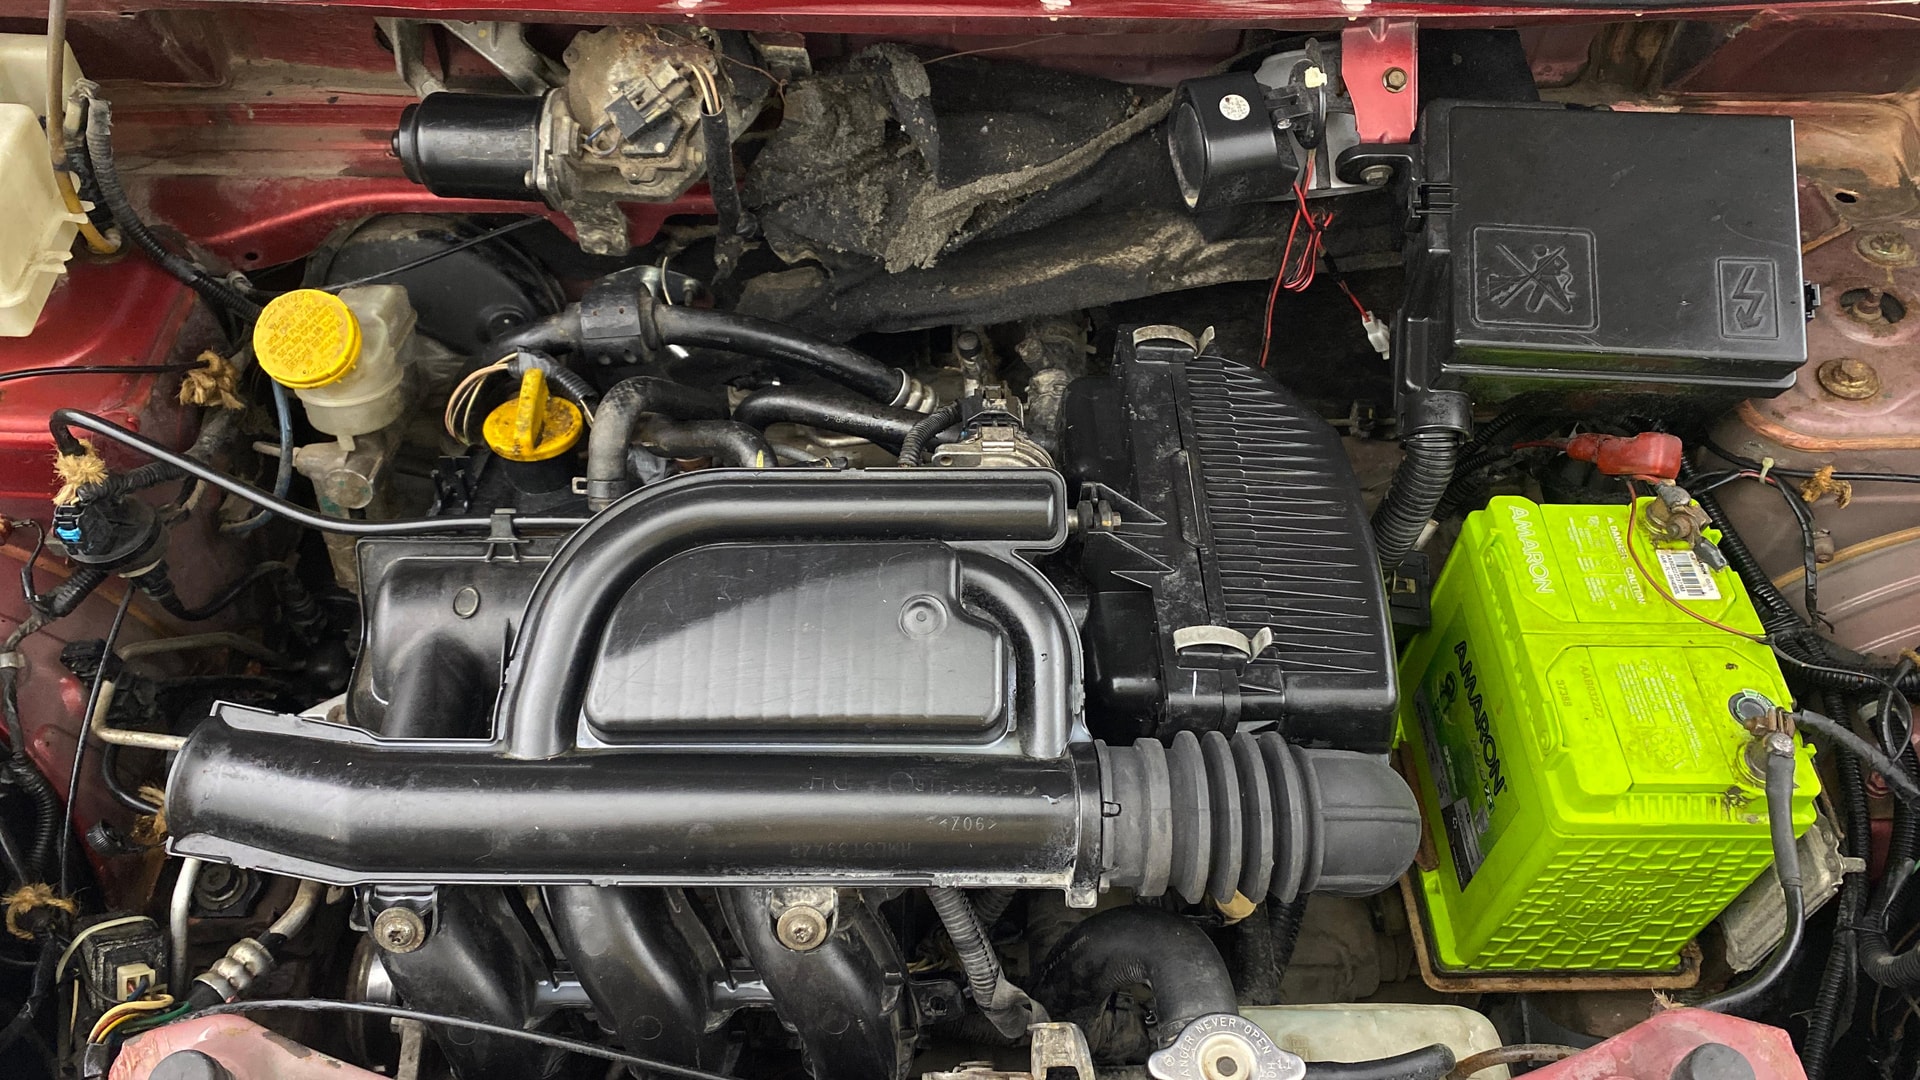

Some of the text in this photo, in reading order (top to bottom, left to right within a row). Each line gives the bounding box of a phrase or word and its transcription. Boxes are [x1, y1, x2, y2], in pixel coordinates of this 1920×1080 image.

[1509, 505, 1555, 594] AMARON
[1608, 525, 1646, 605] DANGER CAUTION
[1454, 640, 1505, 796] AMARON
[1179, 1035, 1195, 1080] ANGER
[1195, 1016, 1236, 1033] NEVER
[1244, 1024, 1272, 1054] OPEN
